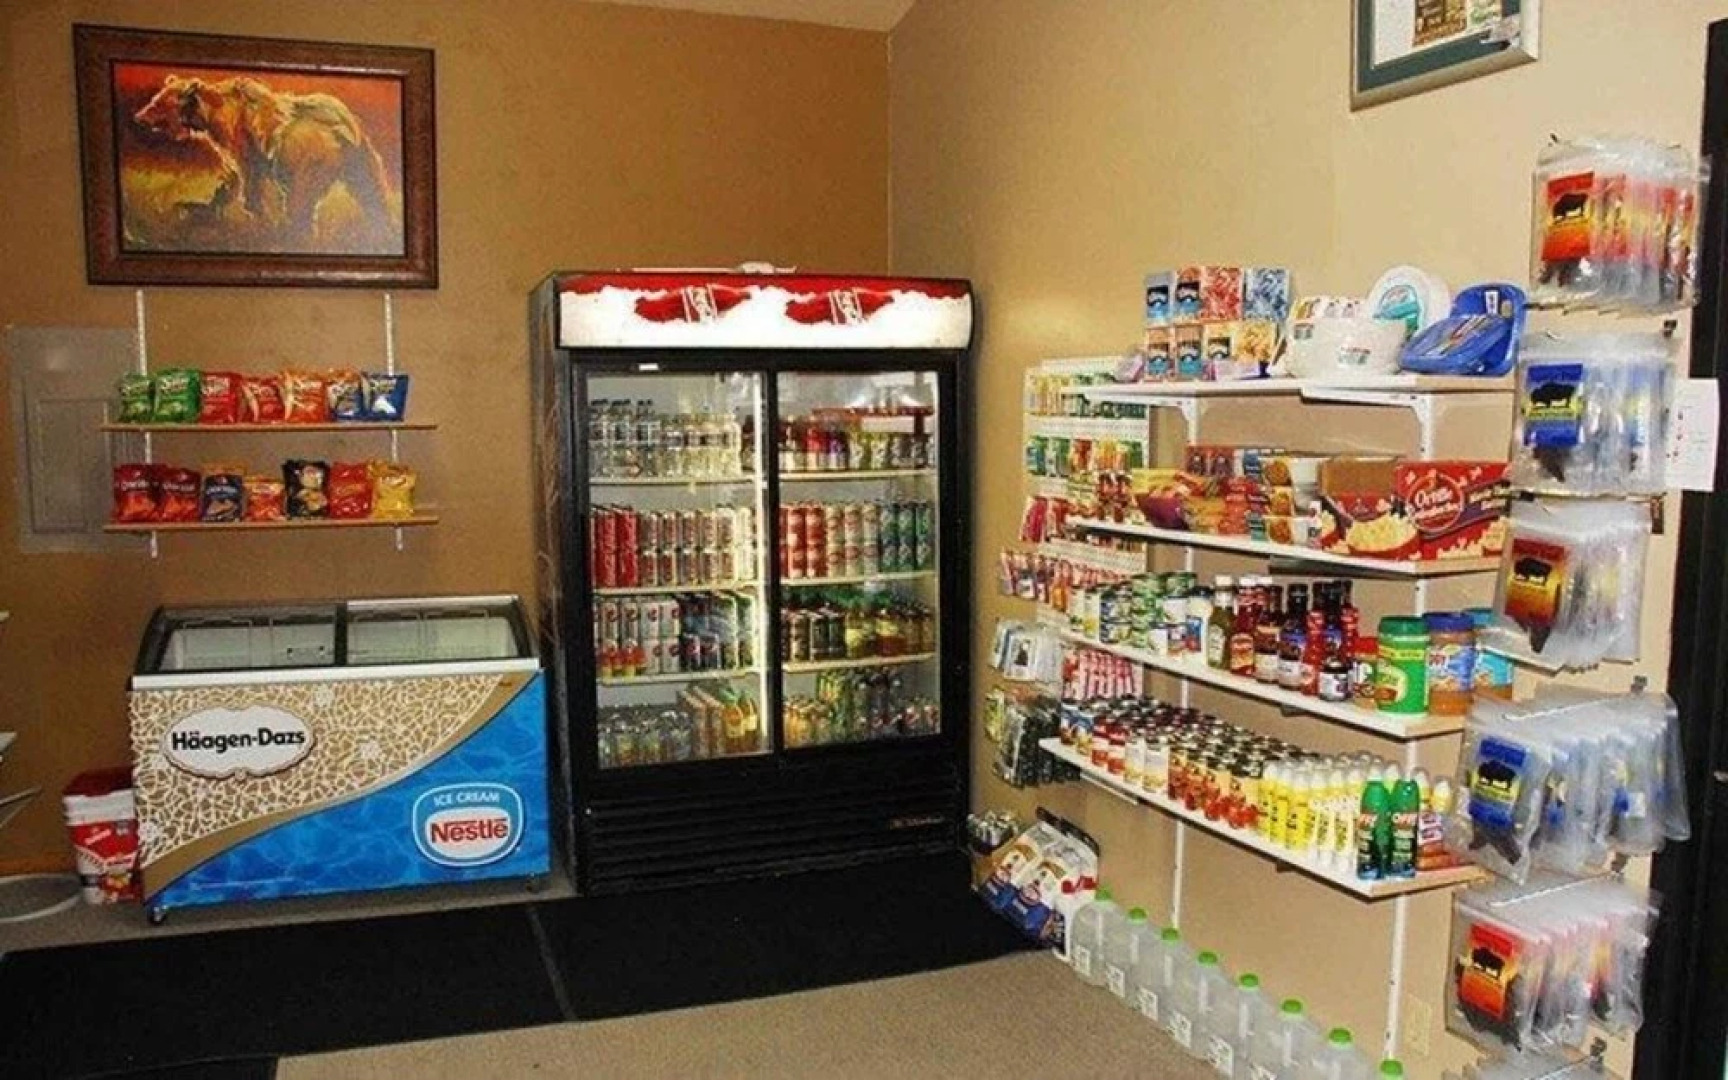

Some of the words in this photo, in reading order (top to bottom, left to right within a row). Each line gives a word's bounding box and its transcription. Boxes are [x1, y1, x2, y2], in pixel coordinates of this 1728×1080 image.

[172, 727, 305, 754] Häagen-Dazs
[433, 793, 453, 806] ICE
[456, 791, 501, 803] CREAM
